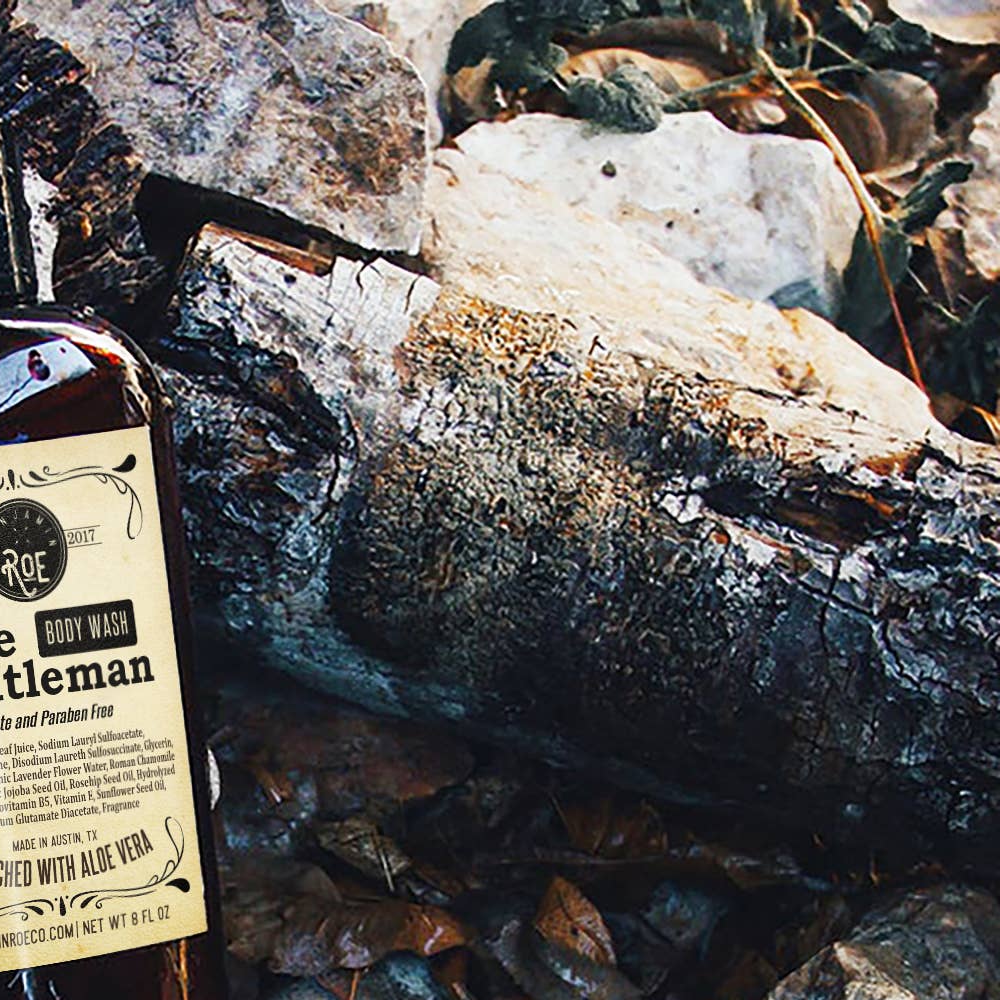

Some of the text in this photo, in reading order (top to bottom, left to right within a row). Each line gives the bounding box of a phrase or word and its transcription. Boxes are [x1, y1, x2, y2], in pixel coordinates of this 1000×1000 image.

[68, 530, 95, 545] 2017
[45, 611, 129, 645] BODY WASH
[15, 712, 37, 729] and
[41, 706, 88, 726] Paraben
[91, 703, 114, 720] Free
[14, 742, 37, 756] Juice,
[38, 739, 69, 751] Sodium
[71, 733, 96, 746] Lauryl
[98, 729, 144, 743] Sulfoacetate,
[12, 753, 52, 769] Disodium
[54, 749, 86, 764] Laureth
[13, 768, 55, 783] Lavender
[54, 766, 81, 778] Flower
[84, 762, 108, 773] Water,
[110, 758, 136, 769] Roman
[137, 751, 175, 765] Chamomile
[3, 785, 30, 799] Jojoba
[32, 781, 52, 794] Seed
[54, 780, 68, 792] Oil,
[70, 776, 101, 789] Rosehip
[103, 772, 120, 784] Seed
[136, 764, 175, 781] Hydrolyzed
[39, 796, 52, 808] B5,
[54, 792, 86, 805] Vitamin
[97, 786, 135, 799] Sunflower
[136, 783, 153, 793] Seed
[15, 811, 59, 825] Glutamate
[61, 805, 100, 818] Diacetate,
[102, 800, 140, 813] Fragrance
[12, 830, 98, 852] MADE IN AUSTIN, TX
[37, 855, 76, 885] WITH
[81, 843, 116, 879] ALOE
[115, 829, 153, 865] VERA
[83, 918, 103, 935] NET
[109, 913, 126, 930] WT
[132, 913, 138, 925] 8
[142, 909, 154, 924] FL
[158, 905, 170, 920] OZ
